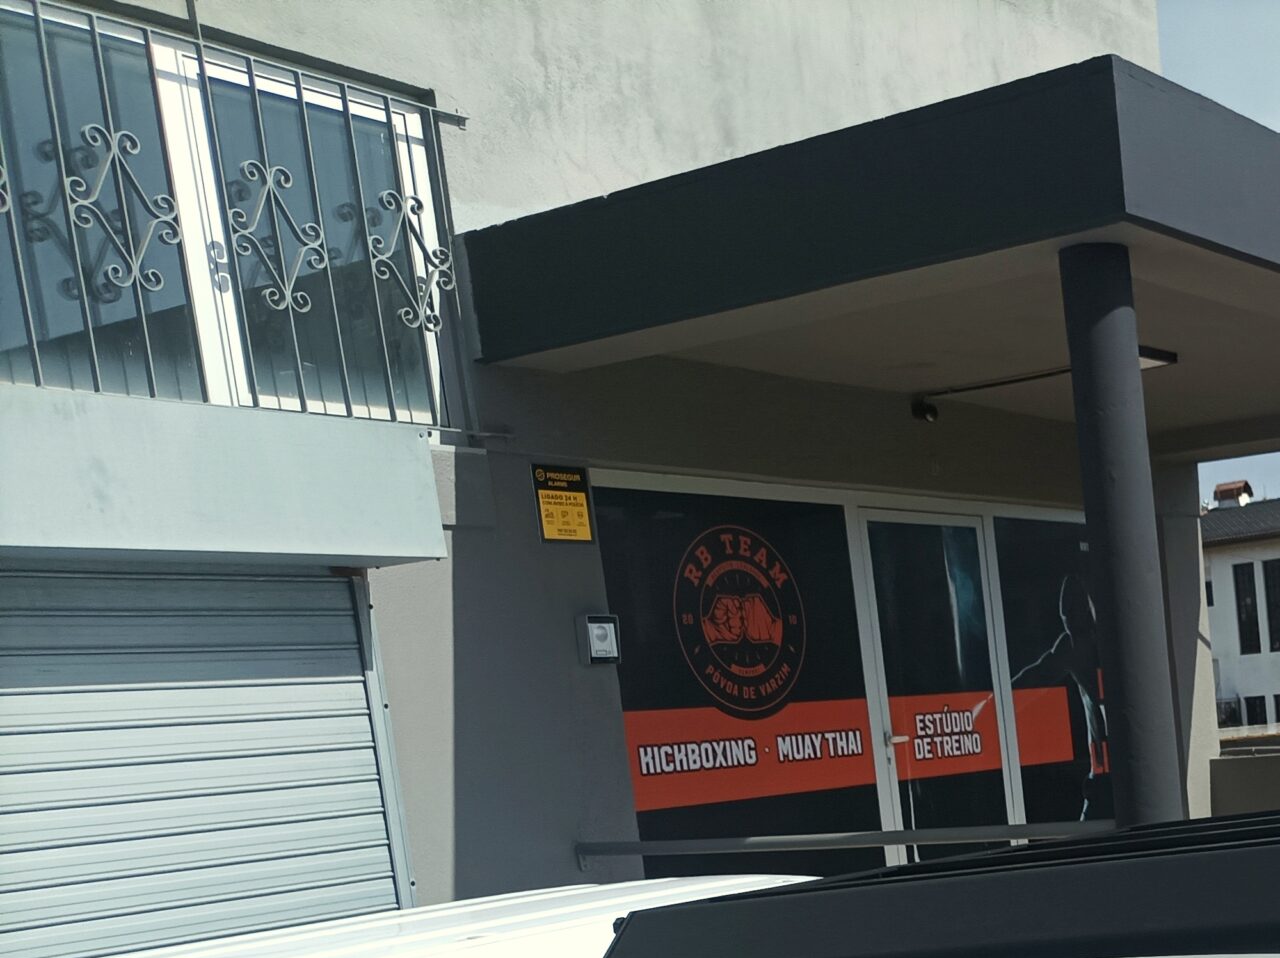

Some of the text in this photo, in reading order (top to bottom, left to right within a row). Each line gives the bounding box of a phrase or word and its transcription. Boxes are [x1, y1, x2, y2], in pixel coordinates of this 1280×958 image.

[546, 472, 581, 481] PROSEGUR
[684, 545, 712, 587] RB
[719, 533, 789, 589] TEAM
[682, 614, 694, 625] 20
[788, 614, 798, 625] 10
[743, 686, 757, 699] DE
[759, 662, 792, 698] VARZIM
[915, 706, 974, 736] ESTÚDIO
[639, 730, 863, 775] KICKBOXING MUAY THAI
[914, 734, 982, 760] DE TREINO
